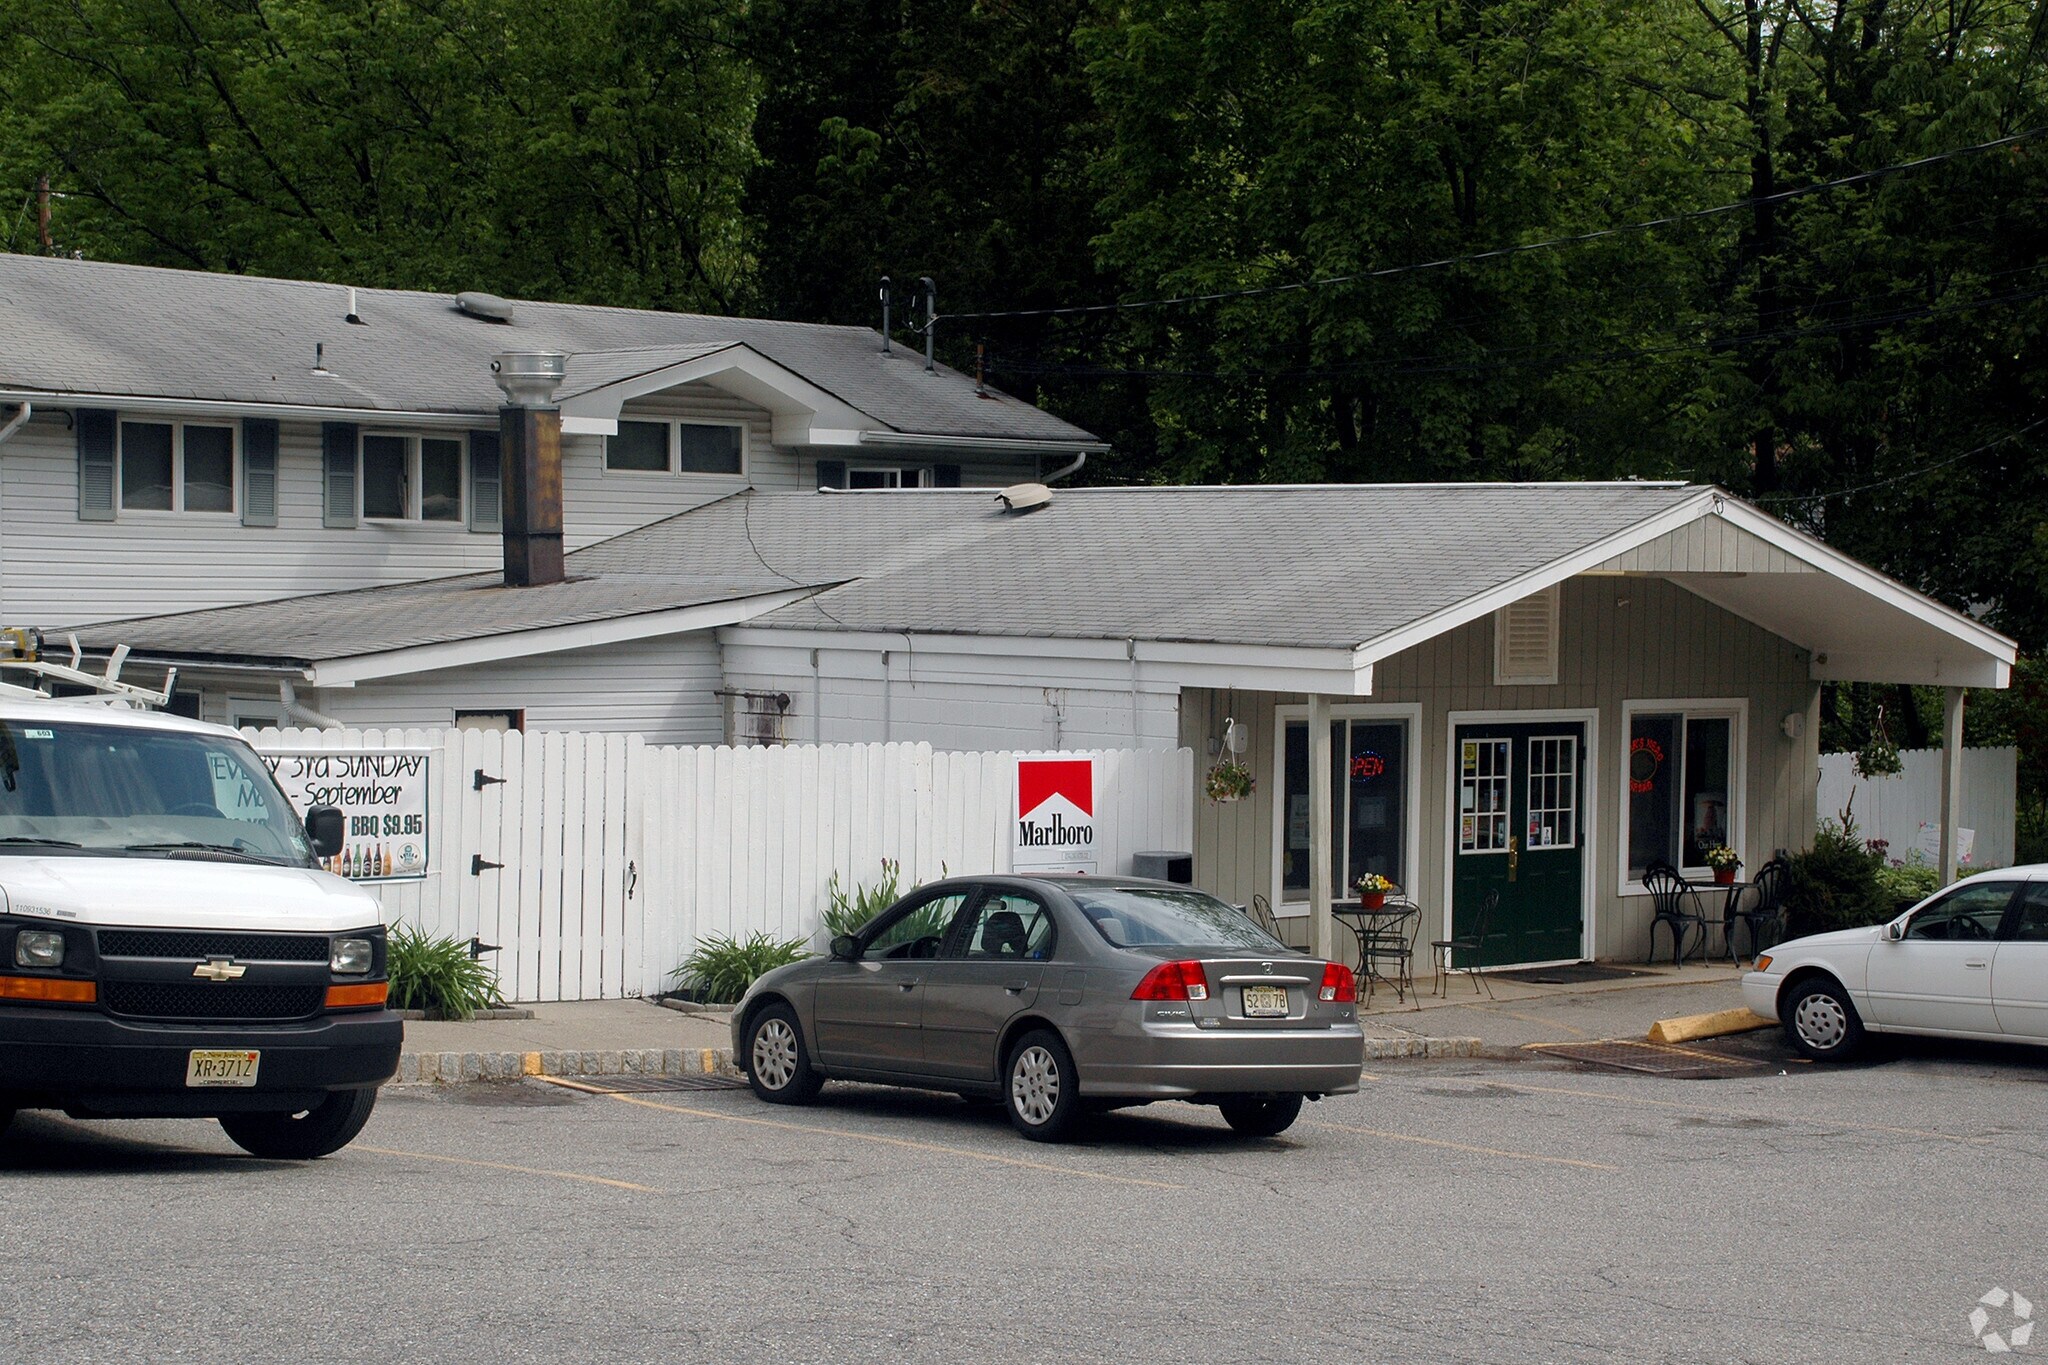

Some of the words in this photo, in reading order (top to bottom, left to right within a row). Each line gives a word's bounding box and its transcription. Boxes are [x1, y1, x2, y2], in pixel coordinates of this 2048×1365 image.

[291, 756, 329, 779] 3rd
[304, 779, 402, 806] September
[351, 815, 379, 838] BBQ
[383, 814, 422, 837] $9.95
[1019, 813, 1093, 846] Marlboro
